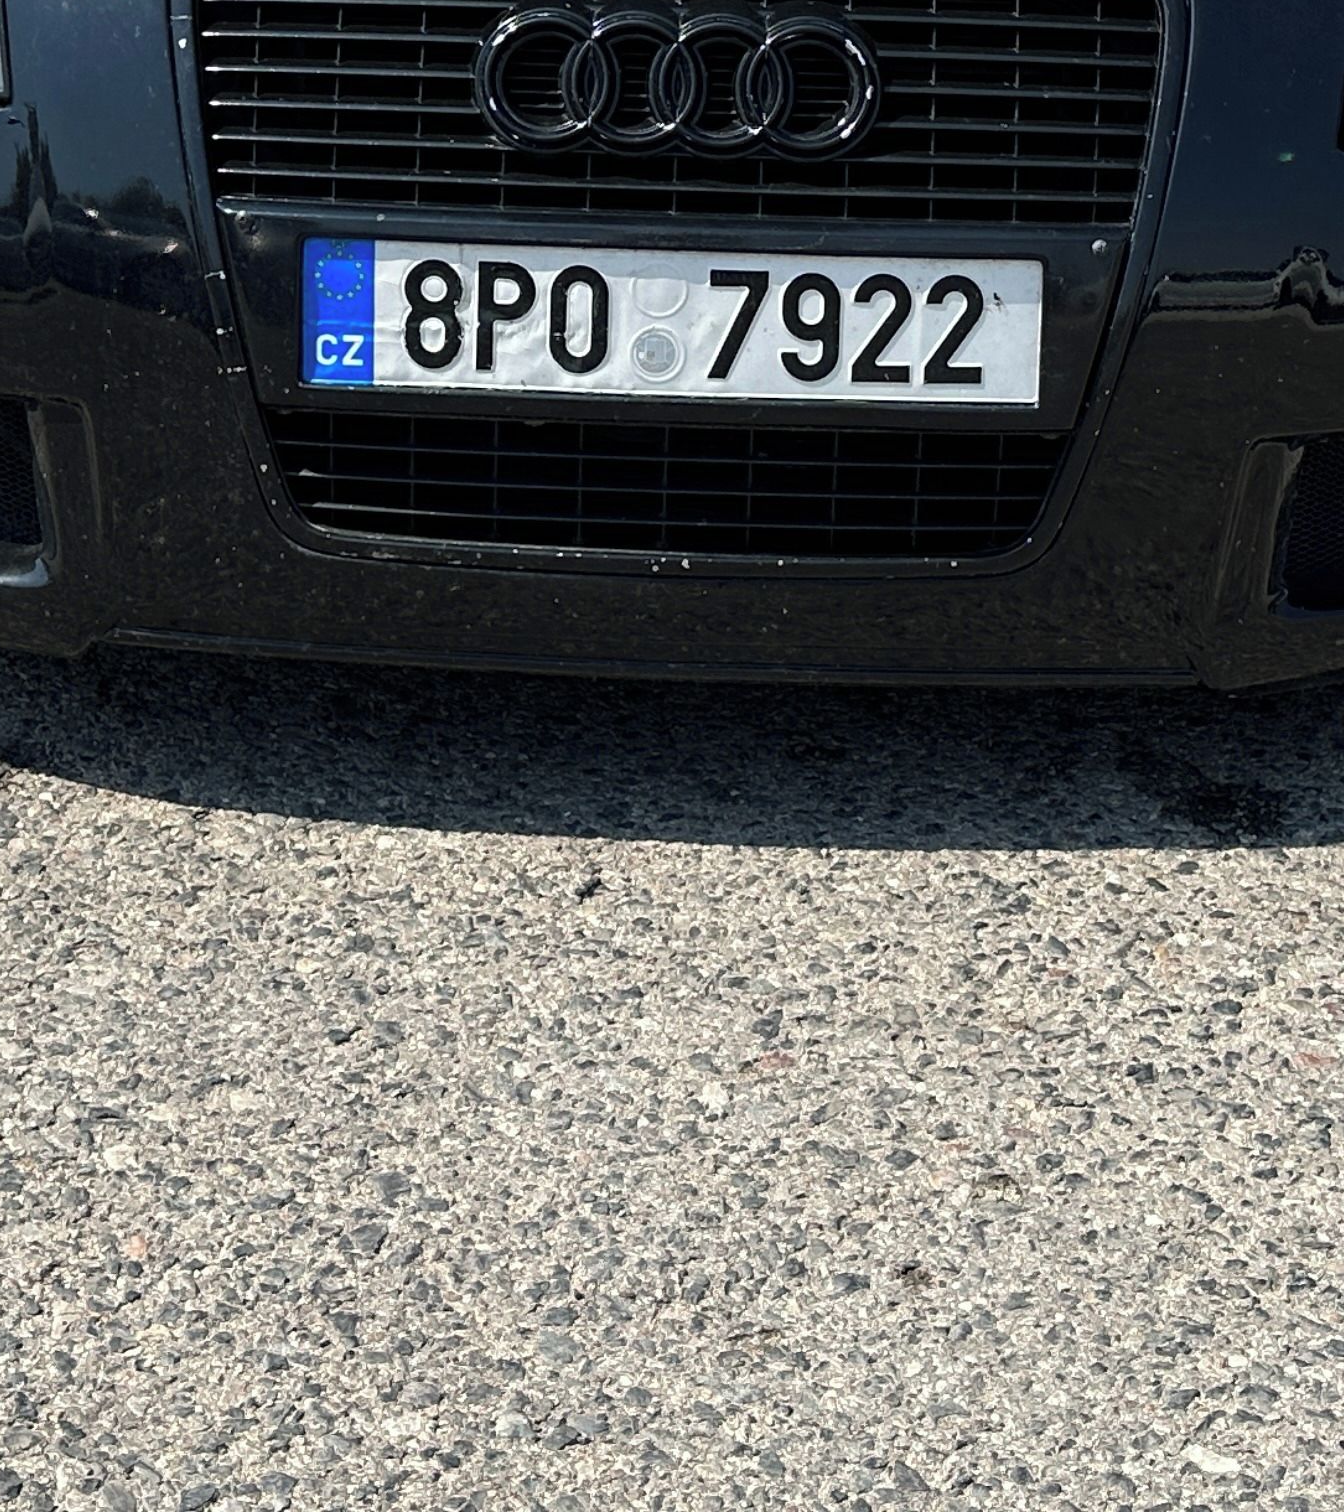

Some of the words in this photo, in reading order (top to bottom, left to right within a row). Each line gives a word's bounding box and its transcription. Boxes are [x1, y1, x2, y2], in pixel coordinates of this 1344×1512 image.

[316, 333, 364, 366] CZ
[403, 259, 610, 374] 8P0
[707, 269, 986, 385] 7922
